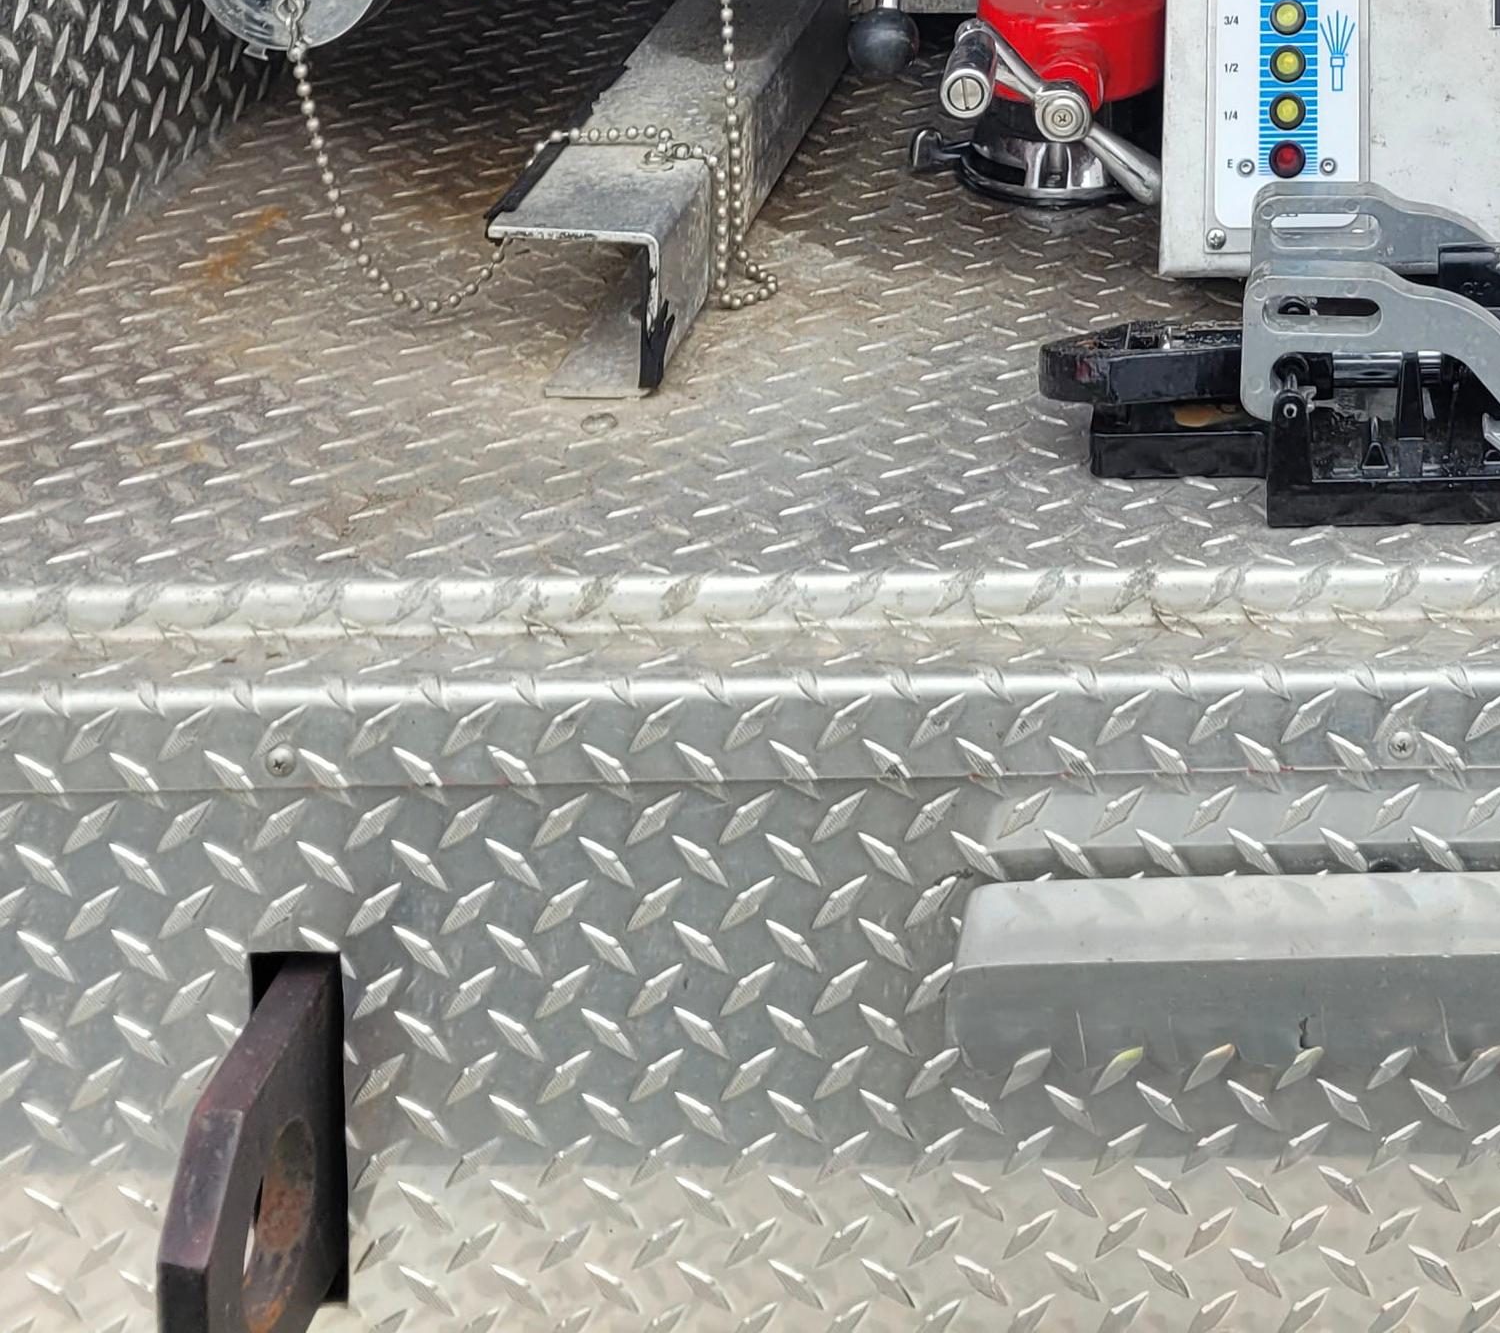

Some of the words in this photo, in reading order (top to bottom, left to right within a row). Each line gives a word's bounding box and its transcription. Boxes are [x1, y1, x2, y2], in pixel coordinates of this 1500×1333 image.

[1223, 15, 1239, 25] 3/4
[1224, 63, 1239, 73] 1/2
[1223, 111, 1238, 120] 1/4
[1227, 159, 1233, 169] E
